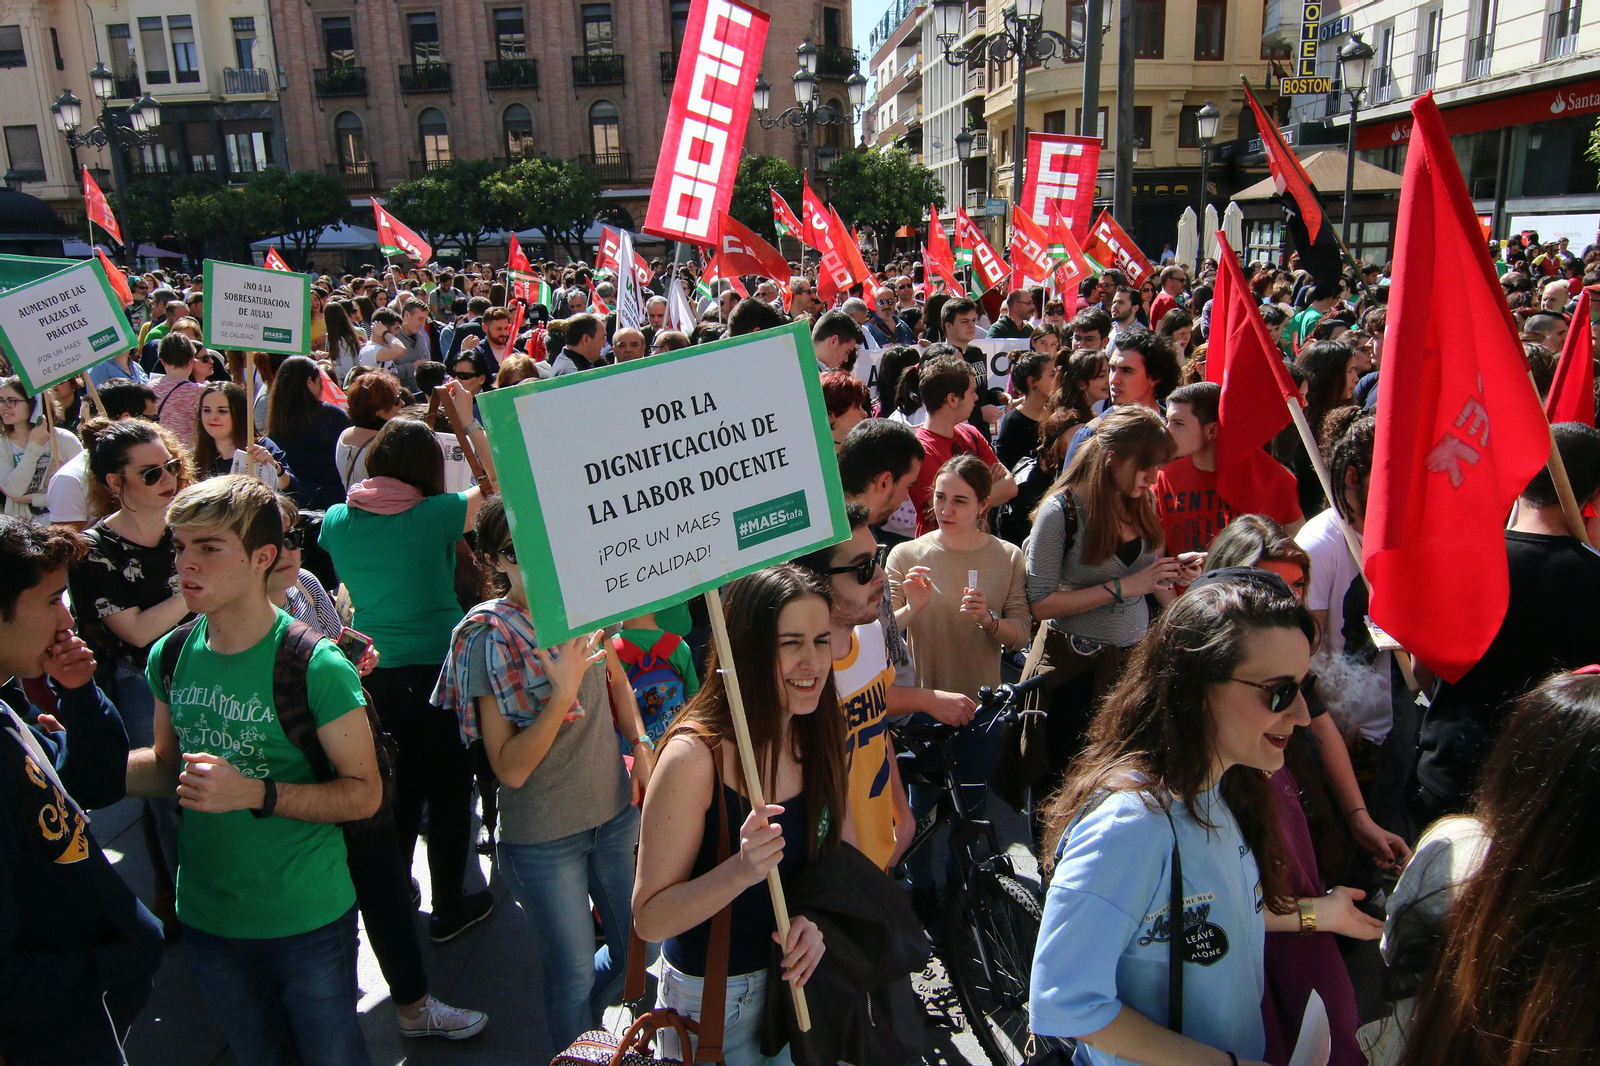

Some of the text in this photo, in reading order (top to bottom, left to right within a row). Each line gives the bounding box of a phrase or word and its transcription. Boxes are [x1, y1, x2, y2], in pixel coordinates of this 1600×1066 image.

[1301, 0, 1321, 76] OTEL
[1321, 16, 1349, 41] OTEL
[1283, 77, 1331, 95] BOSTON
[224, 291, 290, 309] SOBRESATURACIÓN
[257, 284, 262, 292] A
[264, 285, 272, 293] LA
[18, 284, 87, 319] AUMENTO DE LAS
[238, 307, 273, 319] DE AULAS!
[38, 303, 81, 327] PLAZAS DE
[46, 317, 89, 341] PRÁCTICAS
[53, 348, 64, 357] UN
[63, 339, 82, 352] MAES
[42, 366, 52, 376] DE
[640, 391, 717, 429] POR LA
[584, 413, 778, 485] DIGNIFICACIÓN DE
[587, 447, 789, 525] LA LABOR DOCENTE
[739, 508, 803, 537] #MAEStafa
[598, 511, 722, 566] ¡POR UN MAES
[605, 544, 712, 593] DE CALIDAD!
[170, 687, 217, 713] ESCUELA
[174, 725, 255, 757] DE TOD@S
[1197, 893, 1214, 903] NEW
[1185, 928, 1215, 945] LEAVE
[1195, 941, 1212, 950] ME
[1191, 947, 1222, 960] ALONE
